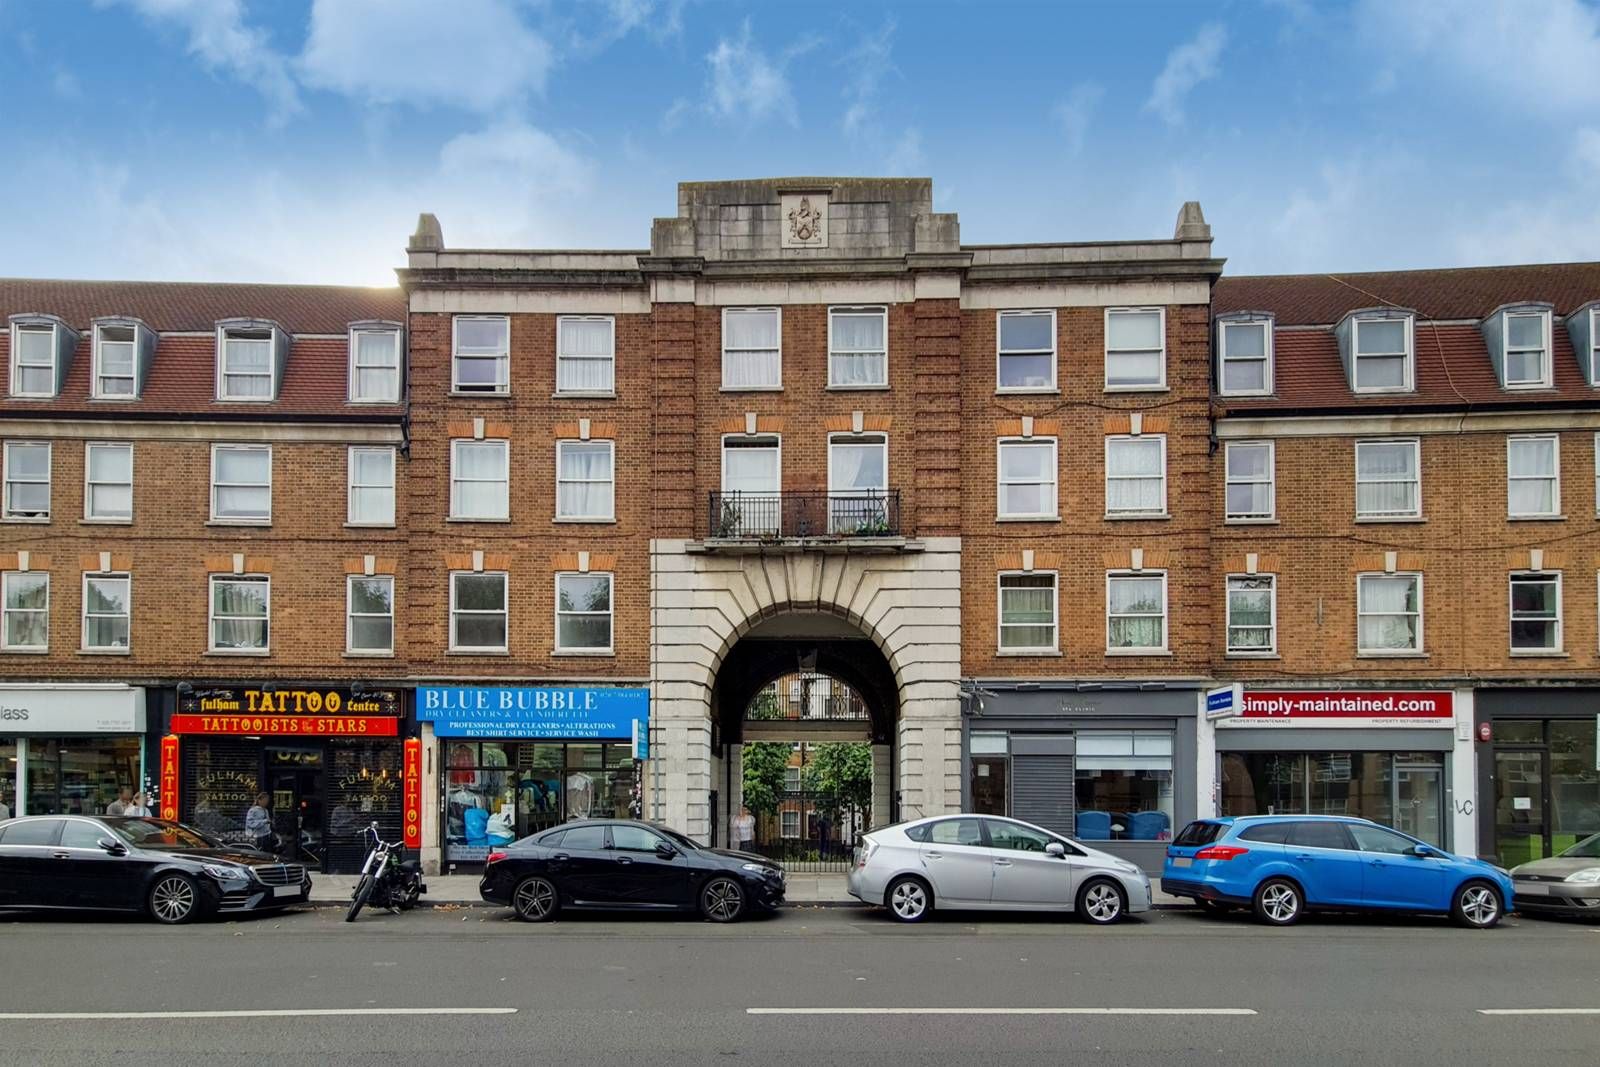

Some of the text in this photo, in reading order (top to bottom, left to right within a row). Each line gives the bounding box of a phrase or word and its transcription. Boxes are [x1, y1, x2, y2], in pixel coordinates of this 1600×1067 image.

[245, 690, 341, 712] TATTOO
[425, 690, 490, 709] BLUE
[499, 691, 598, 710] BUBBLE
[1242, 697, 1436, 715] simply-maintained.com
[202, 718, 299, 732] TATTOOISTS
[317, 719, 367, 732] STARS
[200, 770, 258, 790] FULHAM
[338, 771, 396, 790] FULHAM
[205, 793, 248, 801] TATTOO
[407, 748, 418, 838] TATTOO
